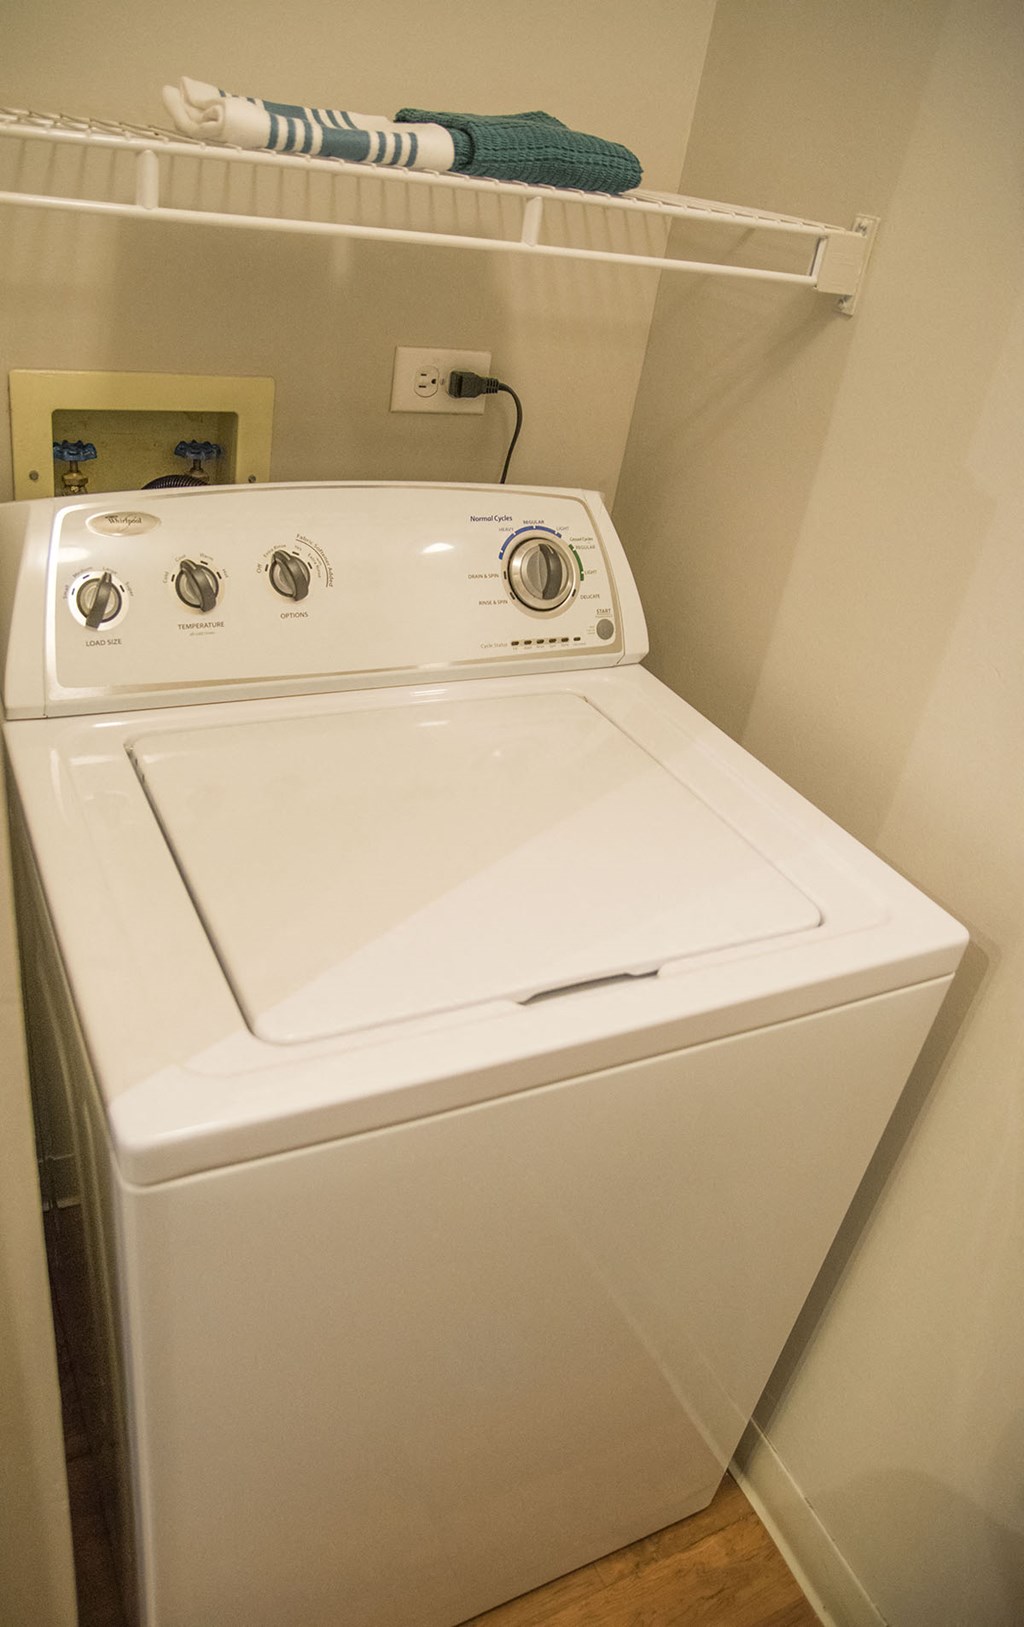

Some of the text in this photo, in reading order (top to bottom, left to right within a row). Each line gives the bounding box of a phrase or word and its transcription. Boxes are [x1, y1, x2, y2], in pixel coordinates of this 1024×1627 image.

[107, 517, 142, 526] Whirlpool
[494, 515, 513, 523] Cycles
[296, 533, 313, 545] Fabric
[280, 611, 309, 619] OPTIONS
[178, 621, 225, 631] TEMPERATURE
[85, 639, 106, 647] LOAD
